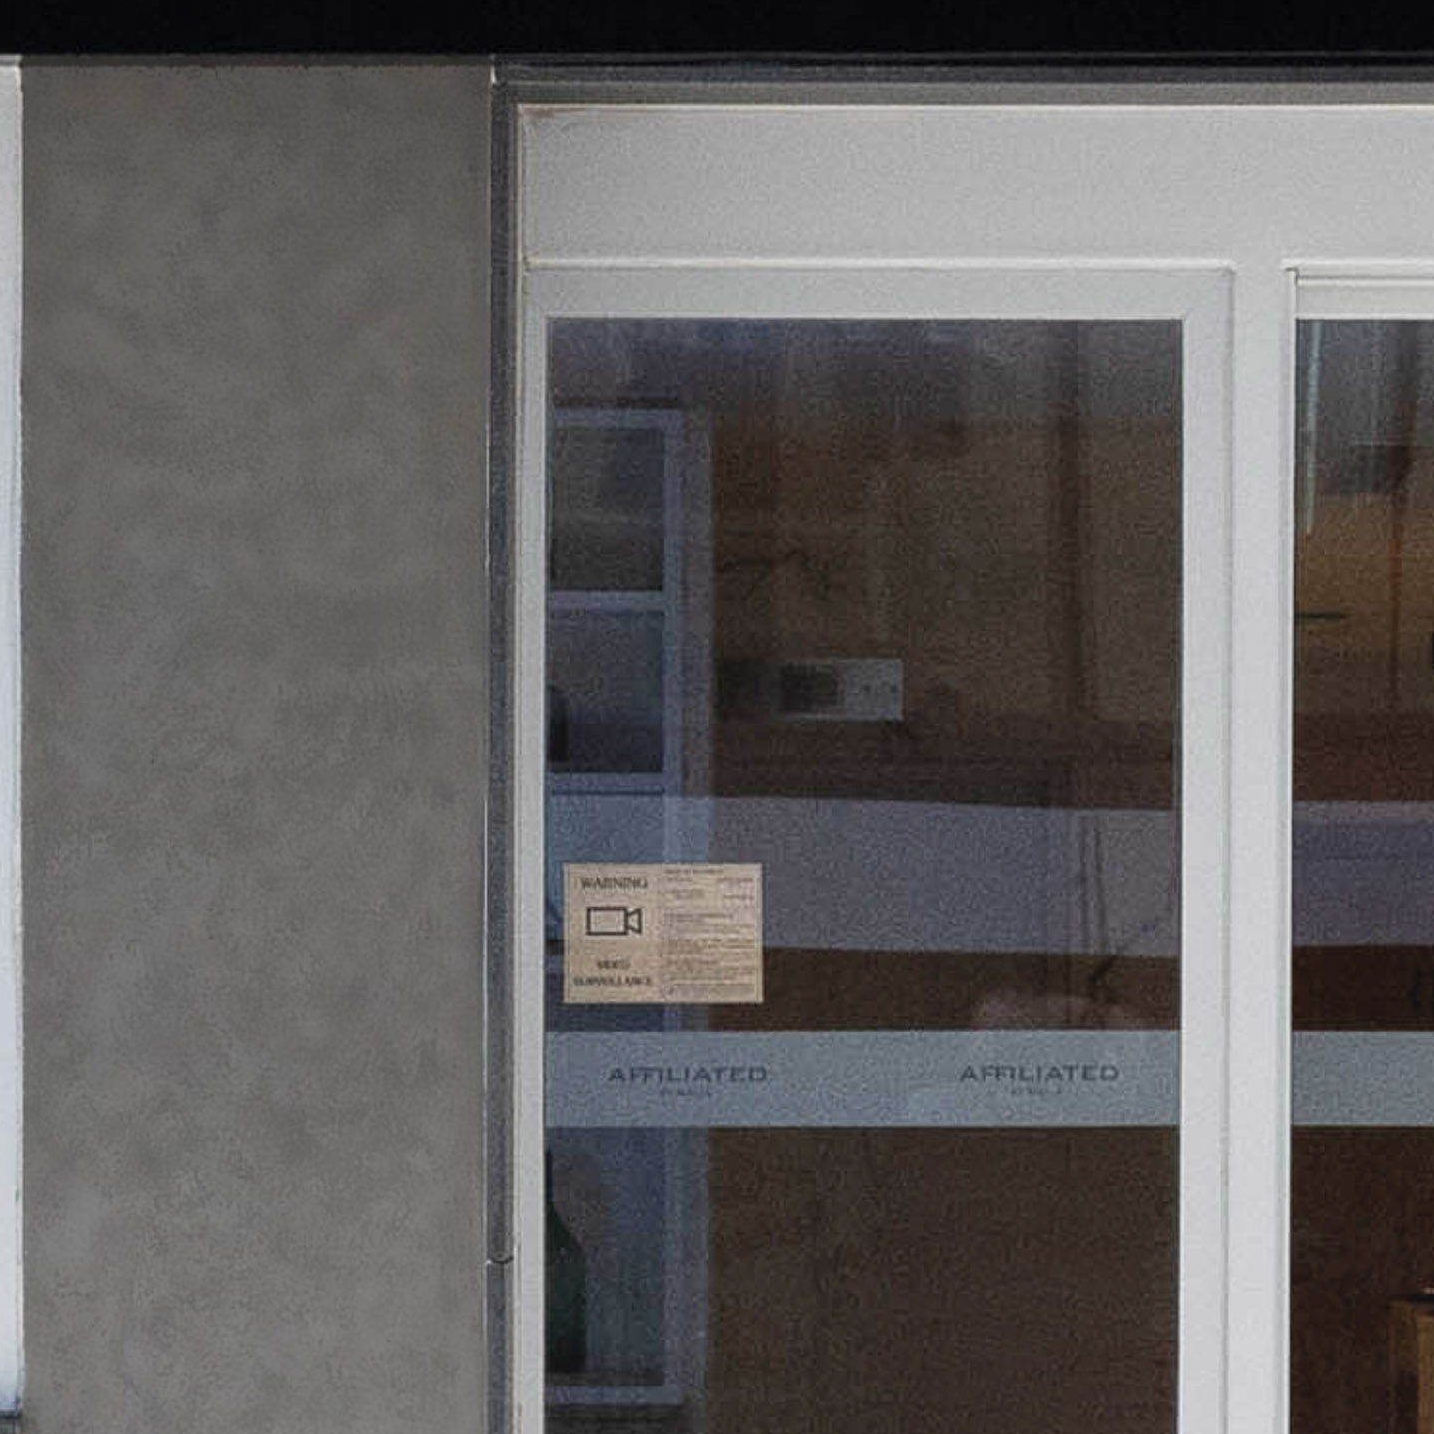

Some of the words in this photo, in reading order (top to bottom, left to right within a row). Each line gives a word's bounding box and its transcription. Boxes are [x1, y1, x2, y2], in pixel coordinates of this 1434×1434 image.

[580, 875, 649, 891] WARNING
[608, 1066, 767, 1084] AFFILIATED
[960, 1065, 1119, 1083] AFFILIATED
